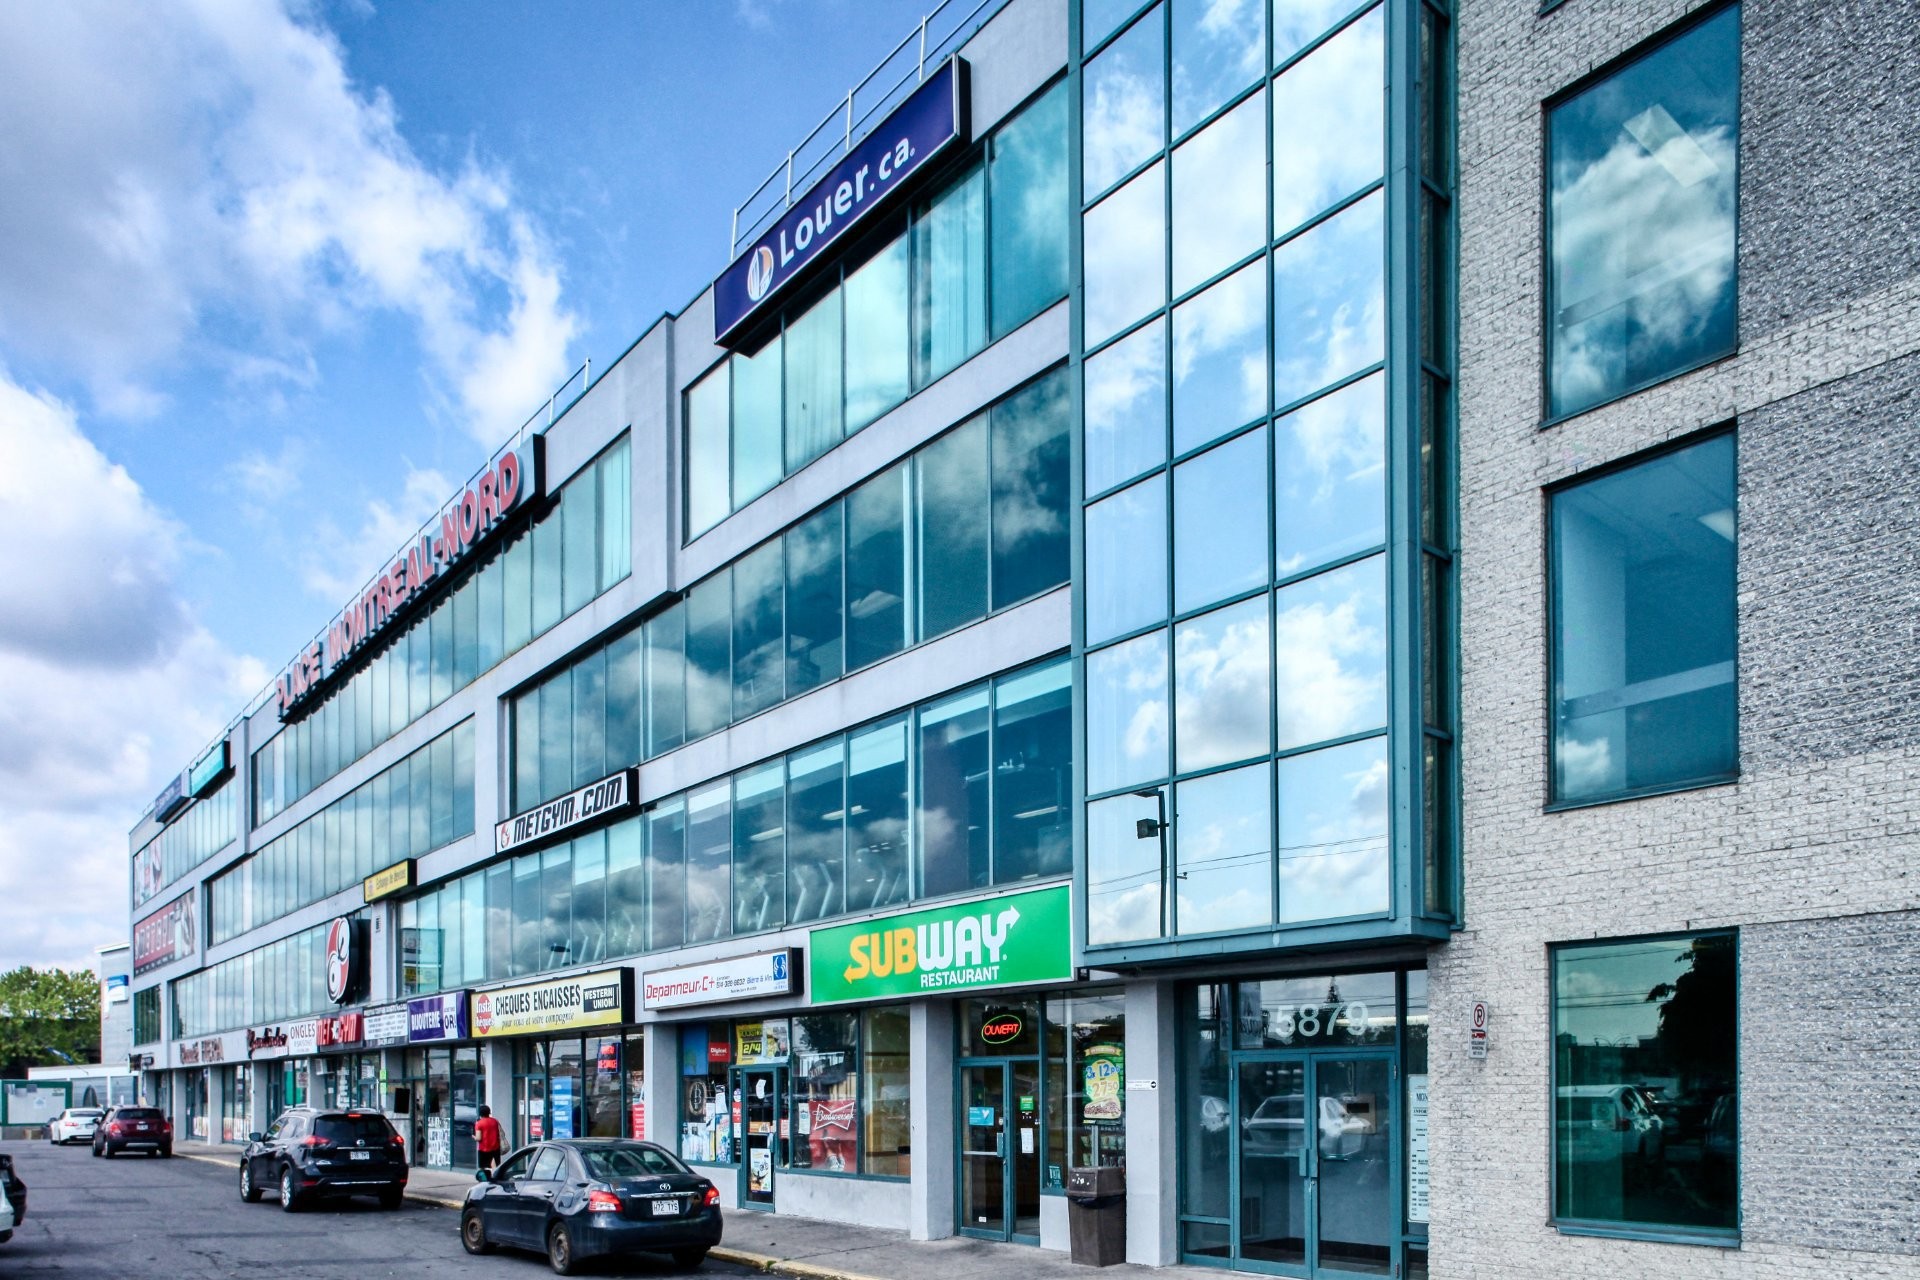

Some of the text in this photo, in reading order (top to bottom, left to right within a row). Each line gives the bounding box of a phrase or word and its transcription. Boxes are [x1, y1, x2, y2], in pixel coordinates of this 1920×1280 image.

[779, 137, 910, 268] Louer.ca
[275, 451, 523, 709] PLACE MONTREAL-NORD
[843, 905, 1020, 984] SUBWAY
[920, 965, 1000, 988] RESTAURANT
[495, 984, 581, 1016] CHEQUES ENCAISSES
[585, 988, 614, 1001] WESTERN
[593, 997, 614, 1010] UNION
[476, 998, 492, 1013] Insta
[316, 1018, 334, 1046] MET
[339, 1014, 358, 1043] GYM
[411, 1010, 441, 1031] BIJOUTERIE
[501, 1017, 512, 1030] pour
[525, 1014, 531, 1026] et
[545, 1010, 575, 1025] compagnie
[984, 1022, 1019, 1036] OUVERT
[1274, 1001, 1369, 1038] 5879
[290, 1023, 316, 1040] ONGLES
[812, 1109, 854, 1122] Budweiser
